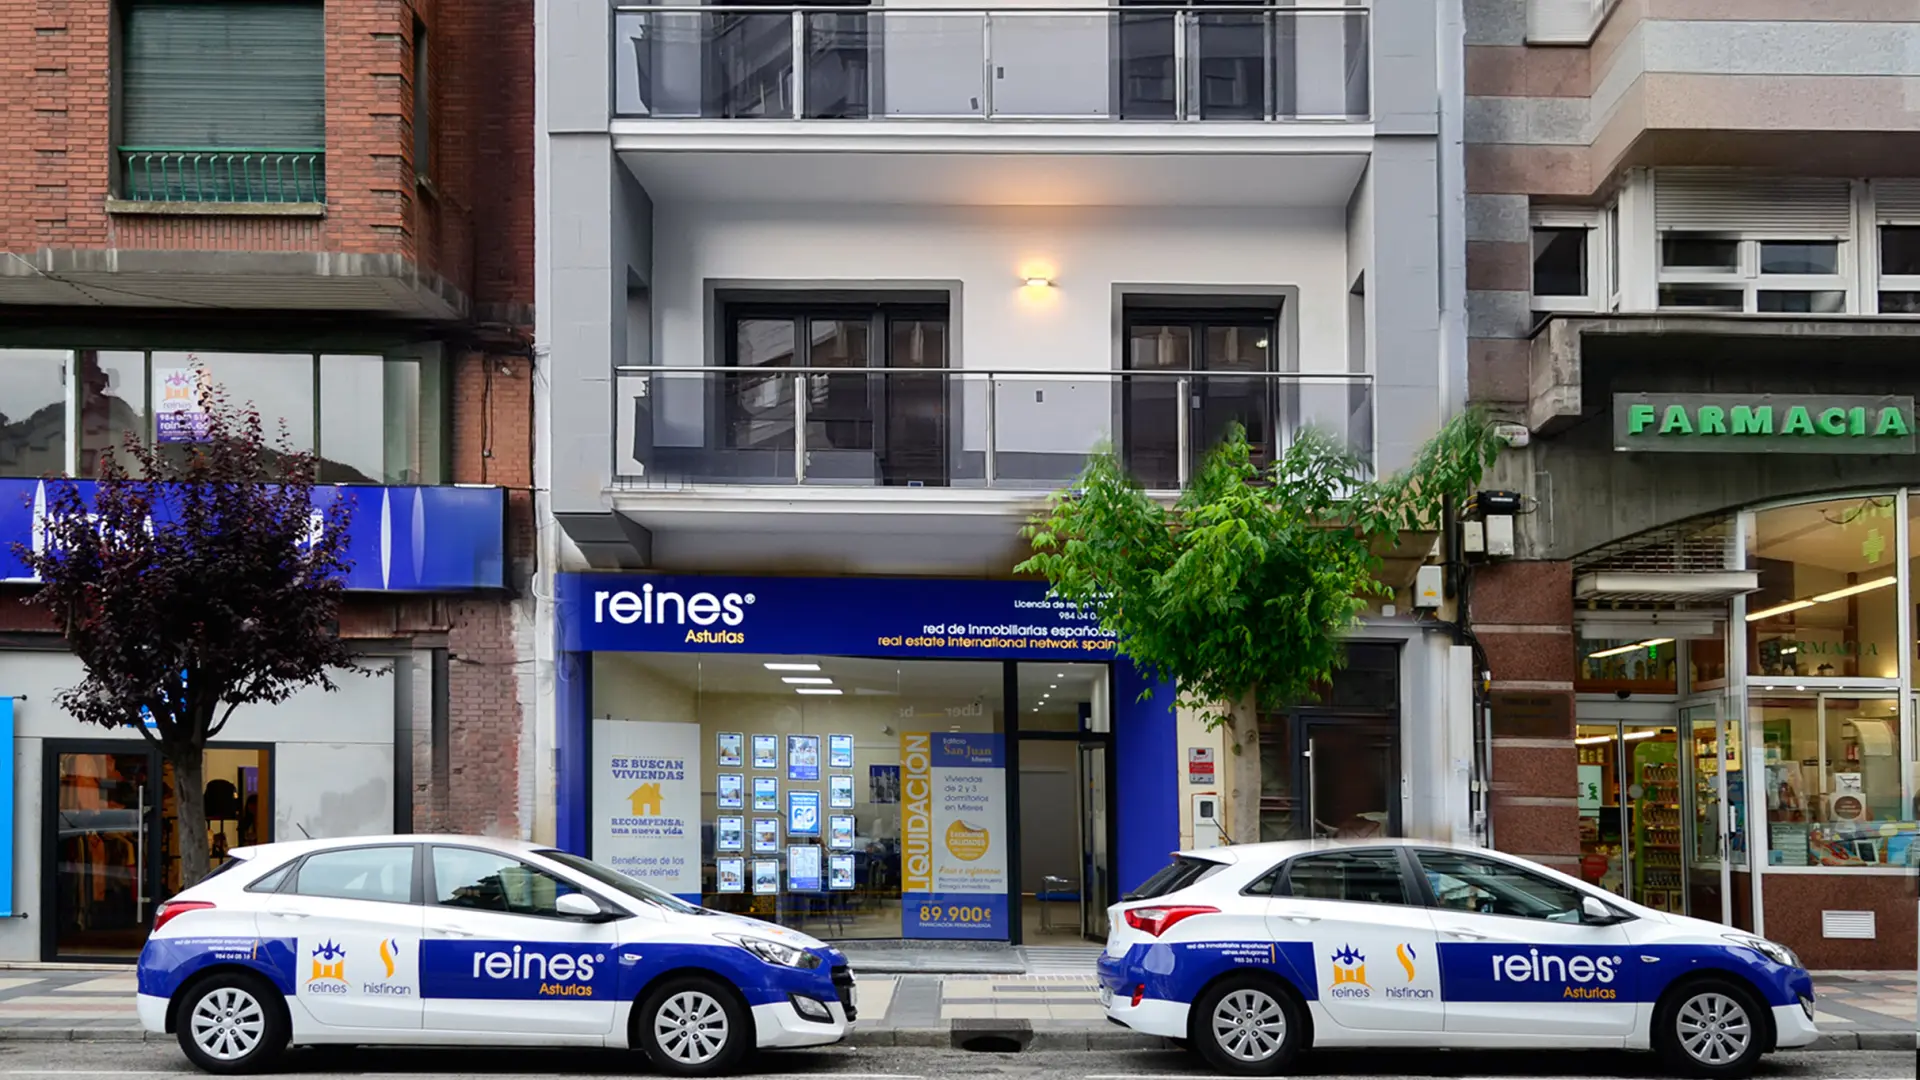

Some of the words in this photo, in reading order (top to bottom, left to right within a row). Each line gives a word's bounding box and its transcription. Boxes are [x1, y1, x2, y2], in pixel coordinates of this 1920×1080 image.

[1627, 404, 1909, 436] FARMACIA
[1059, 612, 1075, 620] 984
[923, 624, 945, 635] red
[948, 624, 966, 635] de
[968, 624, 1048, 636] inmobiliarias
[684, 629, 745, 644] Asturias
[878, 636, 902, 647] real
[905, 637, 945, 647] estate
[948, 637, 1027, 648] international
[1030, 638, 1079, 649] network
[1082, 639, 1116, 651] spain
[943, 745, 963, 755] San
[965, 745, 992, 758] Juan
[611, 758, 628, 769] SE
[631, 759, 684, 770] BUSCAN
[611, 769, 685, 781] VIVIENDAS
[944, 775, 983, 783] Viviendas
[900, 735, 931, 893] LIQUIDACIÓN
[611, 818, 685, 827] RECOMPENSA:
[631, 827, 661, 835] nueva
[662, 826, 683, 835] vida
[659, 857, 671, 865] de
[671, 857, 685, 865] los
[616, 866, 648, 877] rvicios
[308, 982, 348, 993] reines
[363, 982, 412, 995] hisfinan
[539, 983, 593, 996] Asturias
[1331, 987, 1371, 998] reines
[1385, 986, 1434, 999] hisfinan
[1563, 986, 1617, 999] Asturias
